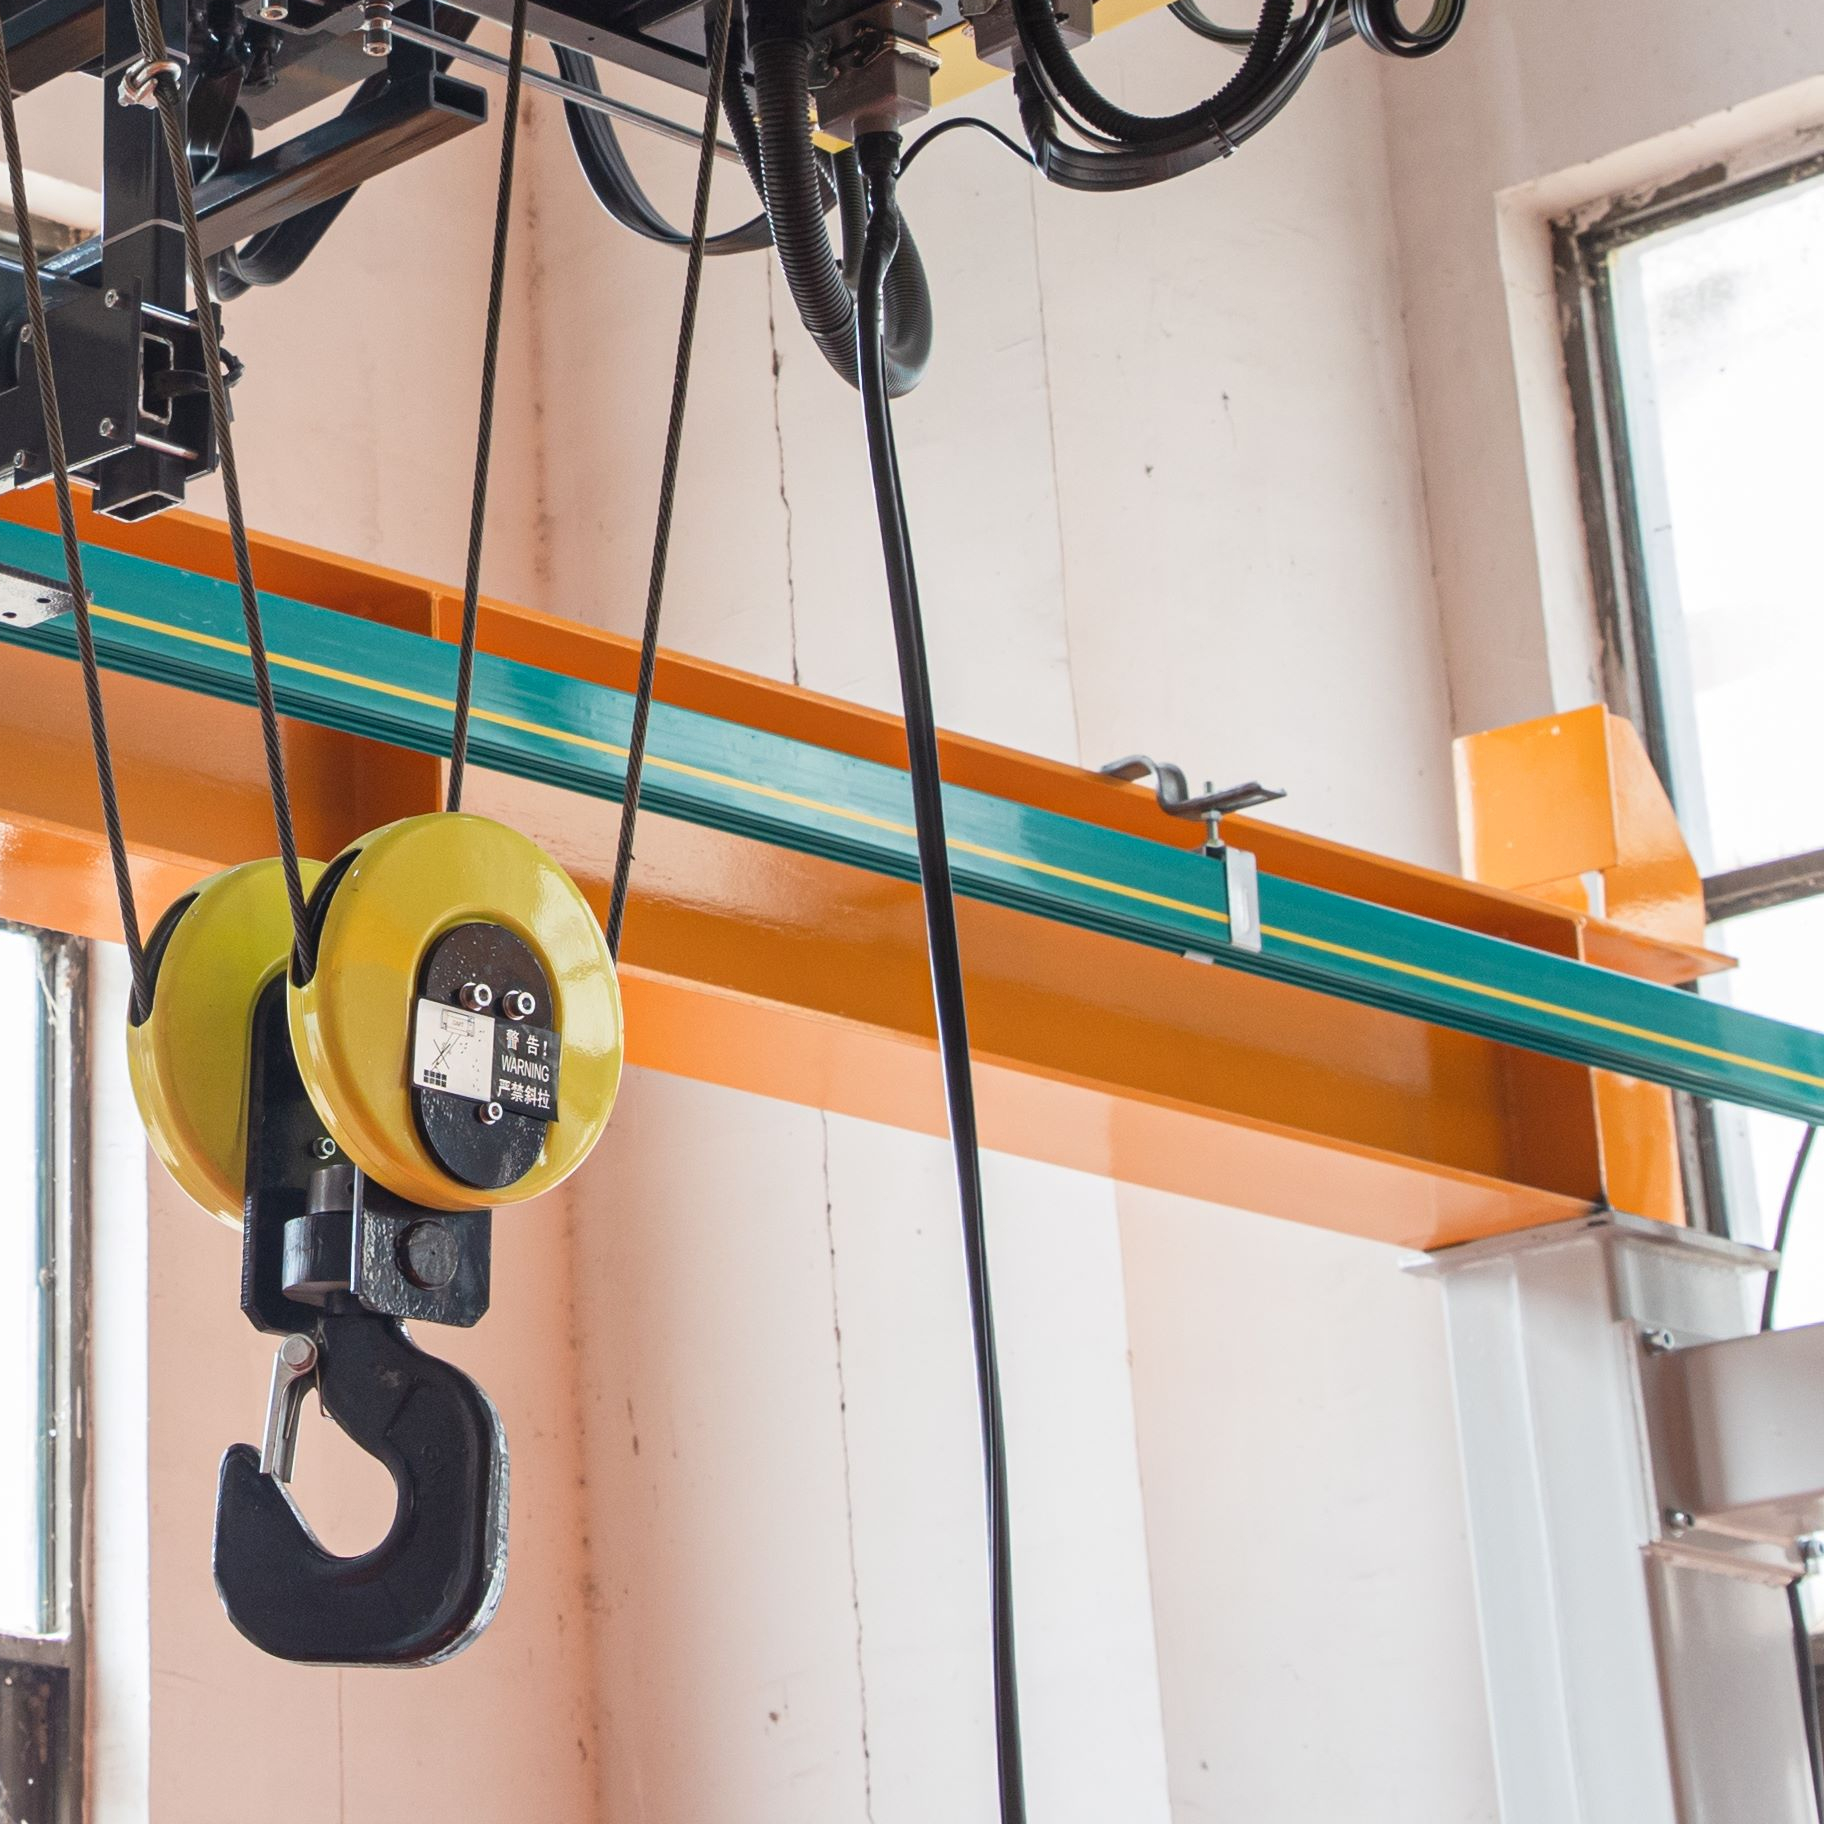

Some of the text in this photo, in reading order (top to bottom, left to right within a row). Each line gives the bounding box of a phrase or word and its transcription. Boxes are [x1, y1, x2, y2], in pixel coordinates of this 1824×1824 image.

[501, 1054, 550, 1083] WARNING
[497, 1078, 551, 1110] 严禁斜拉
